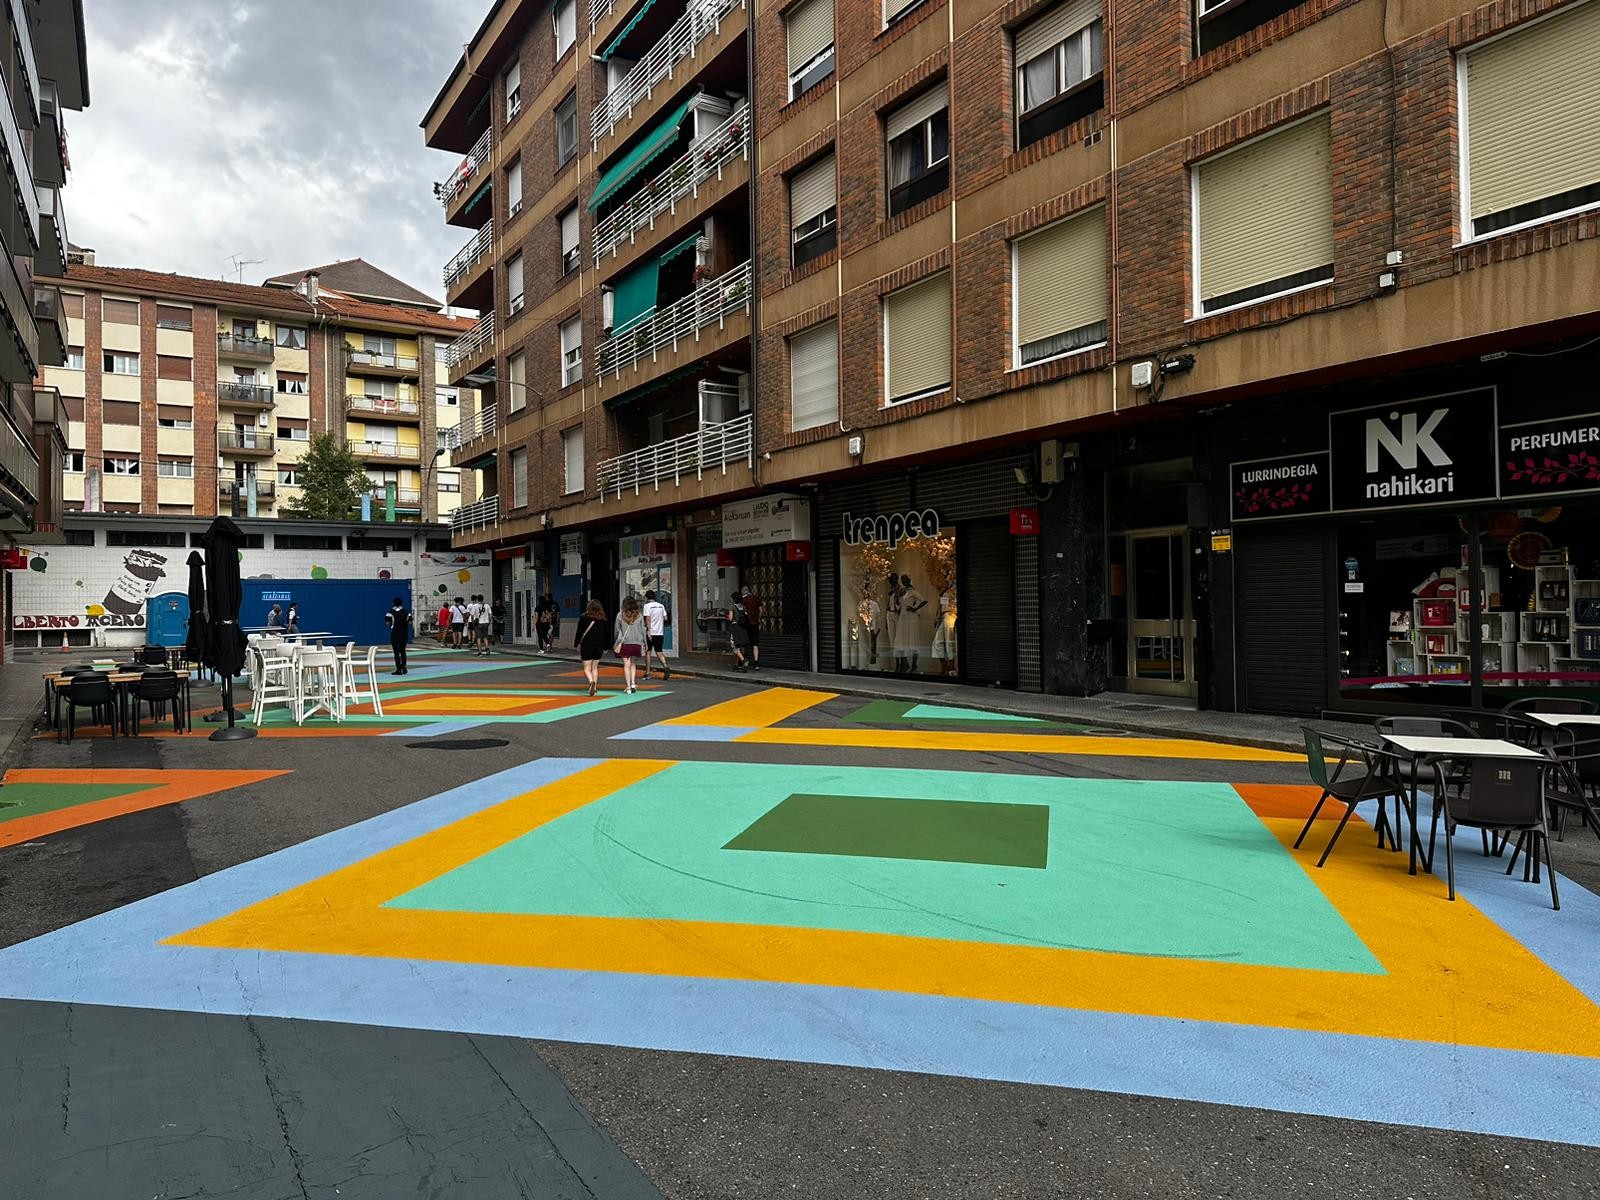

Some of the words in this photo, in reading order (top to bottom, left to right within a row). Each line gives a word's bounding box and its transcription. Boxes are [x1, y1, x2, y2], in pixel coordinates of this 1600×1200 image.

[1510, 427, 1600, 452] PERFUMER
[1242, 464, 1318, 483] LURRINDEGIA
[1366, 472, 1454, 498] nahikari
[842, 508, 939, 550] trenpea
[13, 615, 79, 629] LBERTO
[86, 614, 145, 627] ACERO
